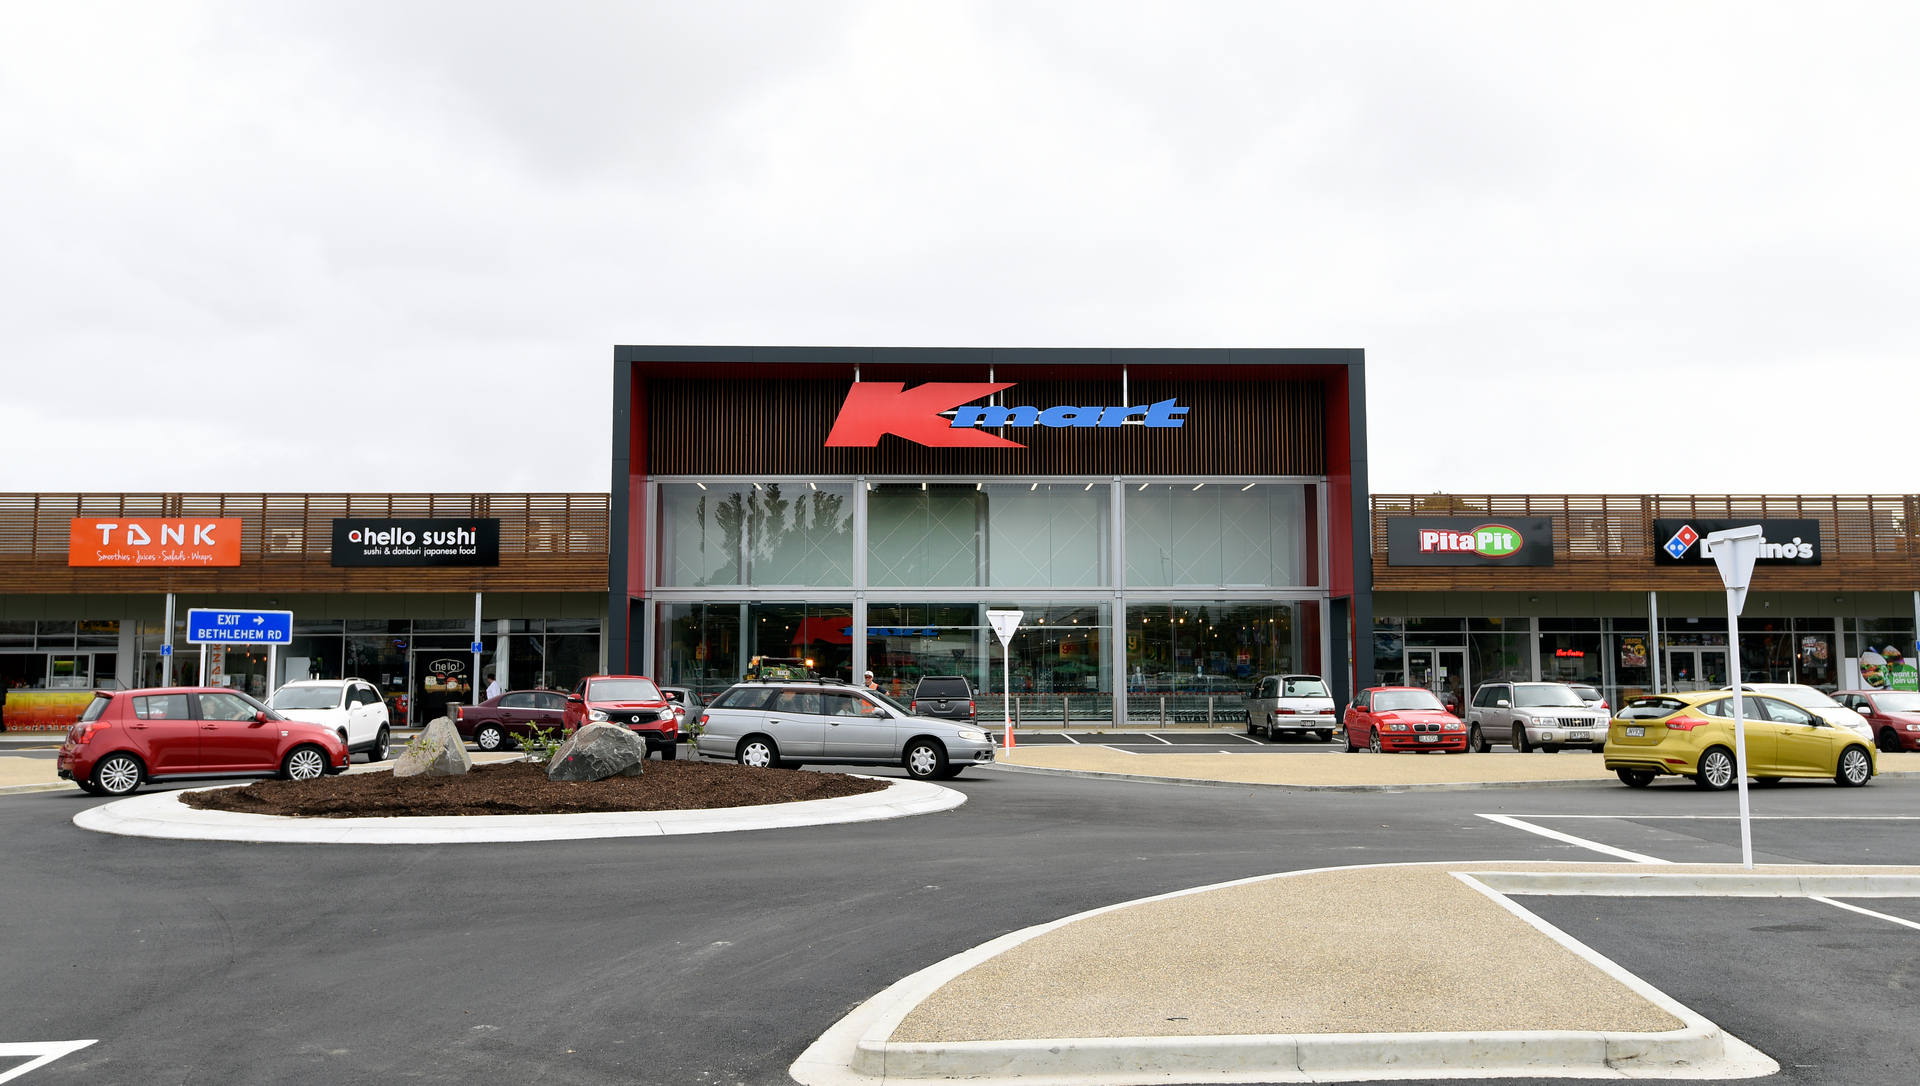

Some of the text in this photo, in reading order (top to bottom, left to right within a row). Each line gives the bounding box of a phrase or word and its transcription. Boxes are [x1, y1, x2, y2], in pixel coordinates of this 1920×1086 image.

[824, 382, 1190, 448] Kmart
[96, 523, 217, 546] TANK
[364, 526, 476, 545] hello sushi
[363, 546, 476, 557] sushi & donburi japanese food
[1700, 537, 1814, 559] Dino's
[96, 550, 213, 564] Smoothies Juices Salads Wraps
[217, 614, 241, 625] EXIT
[198, 628, 282, 640] BETHLEHEM RD
[211, 643, 222, 687] TANK
[1892, 677, 1906, 685] join
